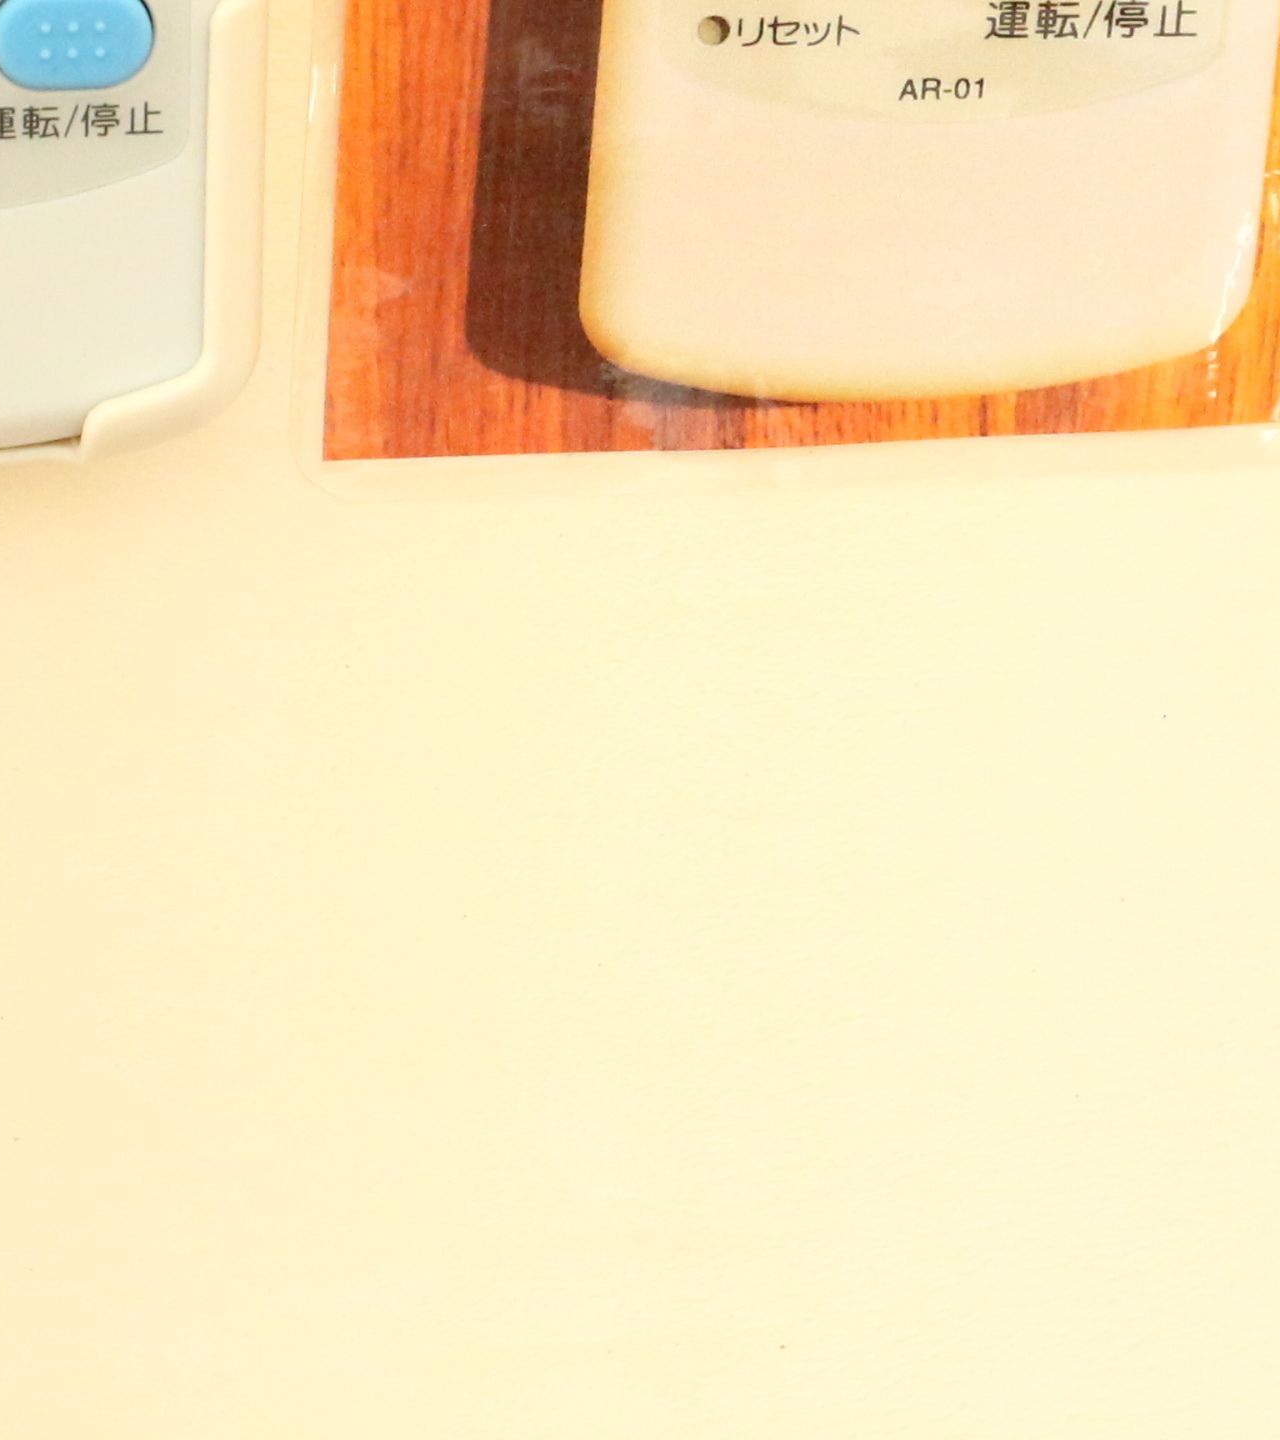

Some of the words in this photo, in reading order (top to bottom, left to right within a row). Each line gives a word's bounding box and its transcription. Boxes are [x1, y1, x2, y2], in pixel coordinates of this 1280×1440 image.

[737, 14, 860, 47] リセット
[984, 0, 1199, 41] 運転/停止
[898, 76, 985, 102] AR-01
